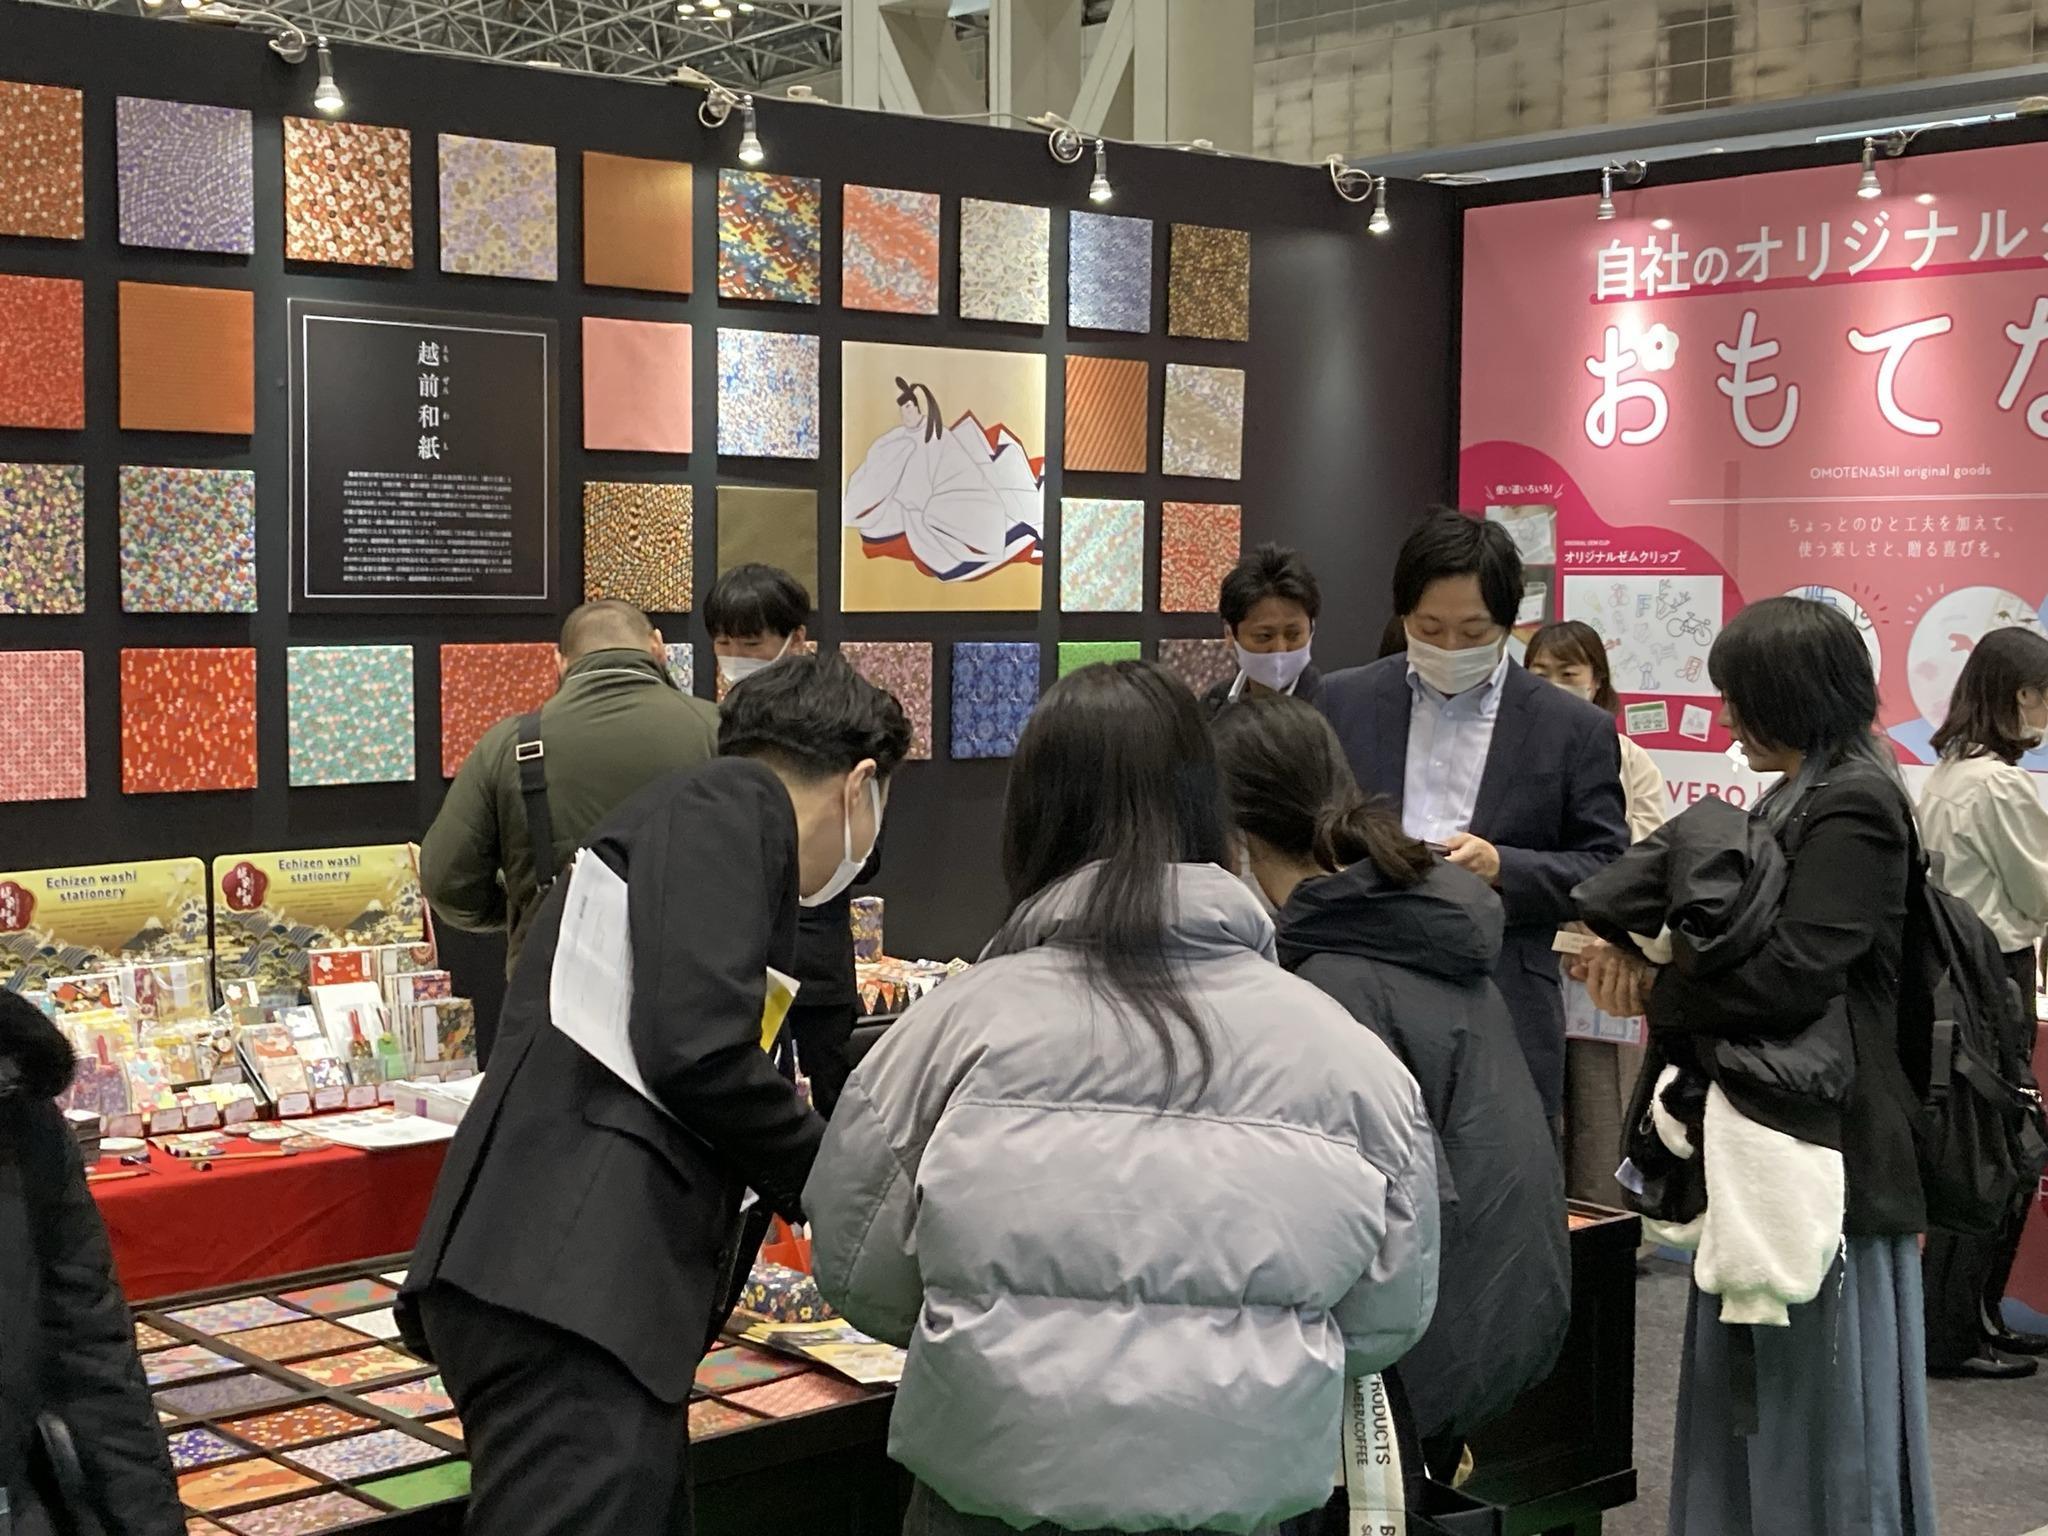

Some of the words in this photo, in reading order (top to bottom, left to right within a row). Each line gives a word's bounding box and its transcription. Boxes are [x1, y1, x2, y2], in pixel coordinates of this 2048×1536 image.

[1596, 209, 2048, 301] 自社のオリジナル
[417, 340, 440, 460] 越前和紙
[1810, 465, 1900, 479] OMOTENASHI
[1904, 464, 1950, 480] original
[1954, 464, 1992, 479] goods
[1788, 515, 2014, 533] ちょっとのひと工夫を加えて、
[1564, 550, 1680, 564] オリジナルゼムクリップ
[1798, 540, 2001, 558] 使う楽しさと、贈る喜びを。
[278, 858, 323, 870] Echizen
[327, 855, 361, 867] washi
[46, 876, 96, 889] Echizen
[100, 870, 137, 884] washi
[290, 871, 351, 883] stationery
[60, 887, 126, 902] stationery
[1371, 1372, 1391, 1465] RODUCTS
